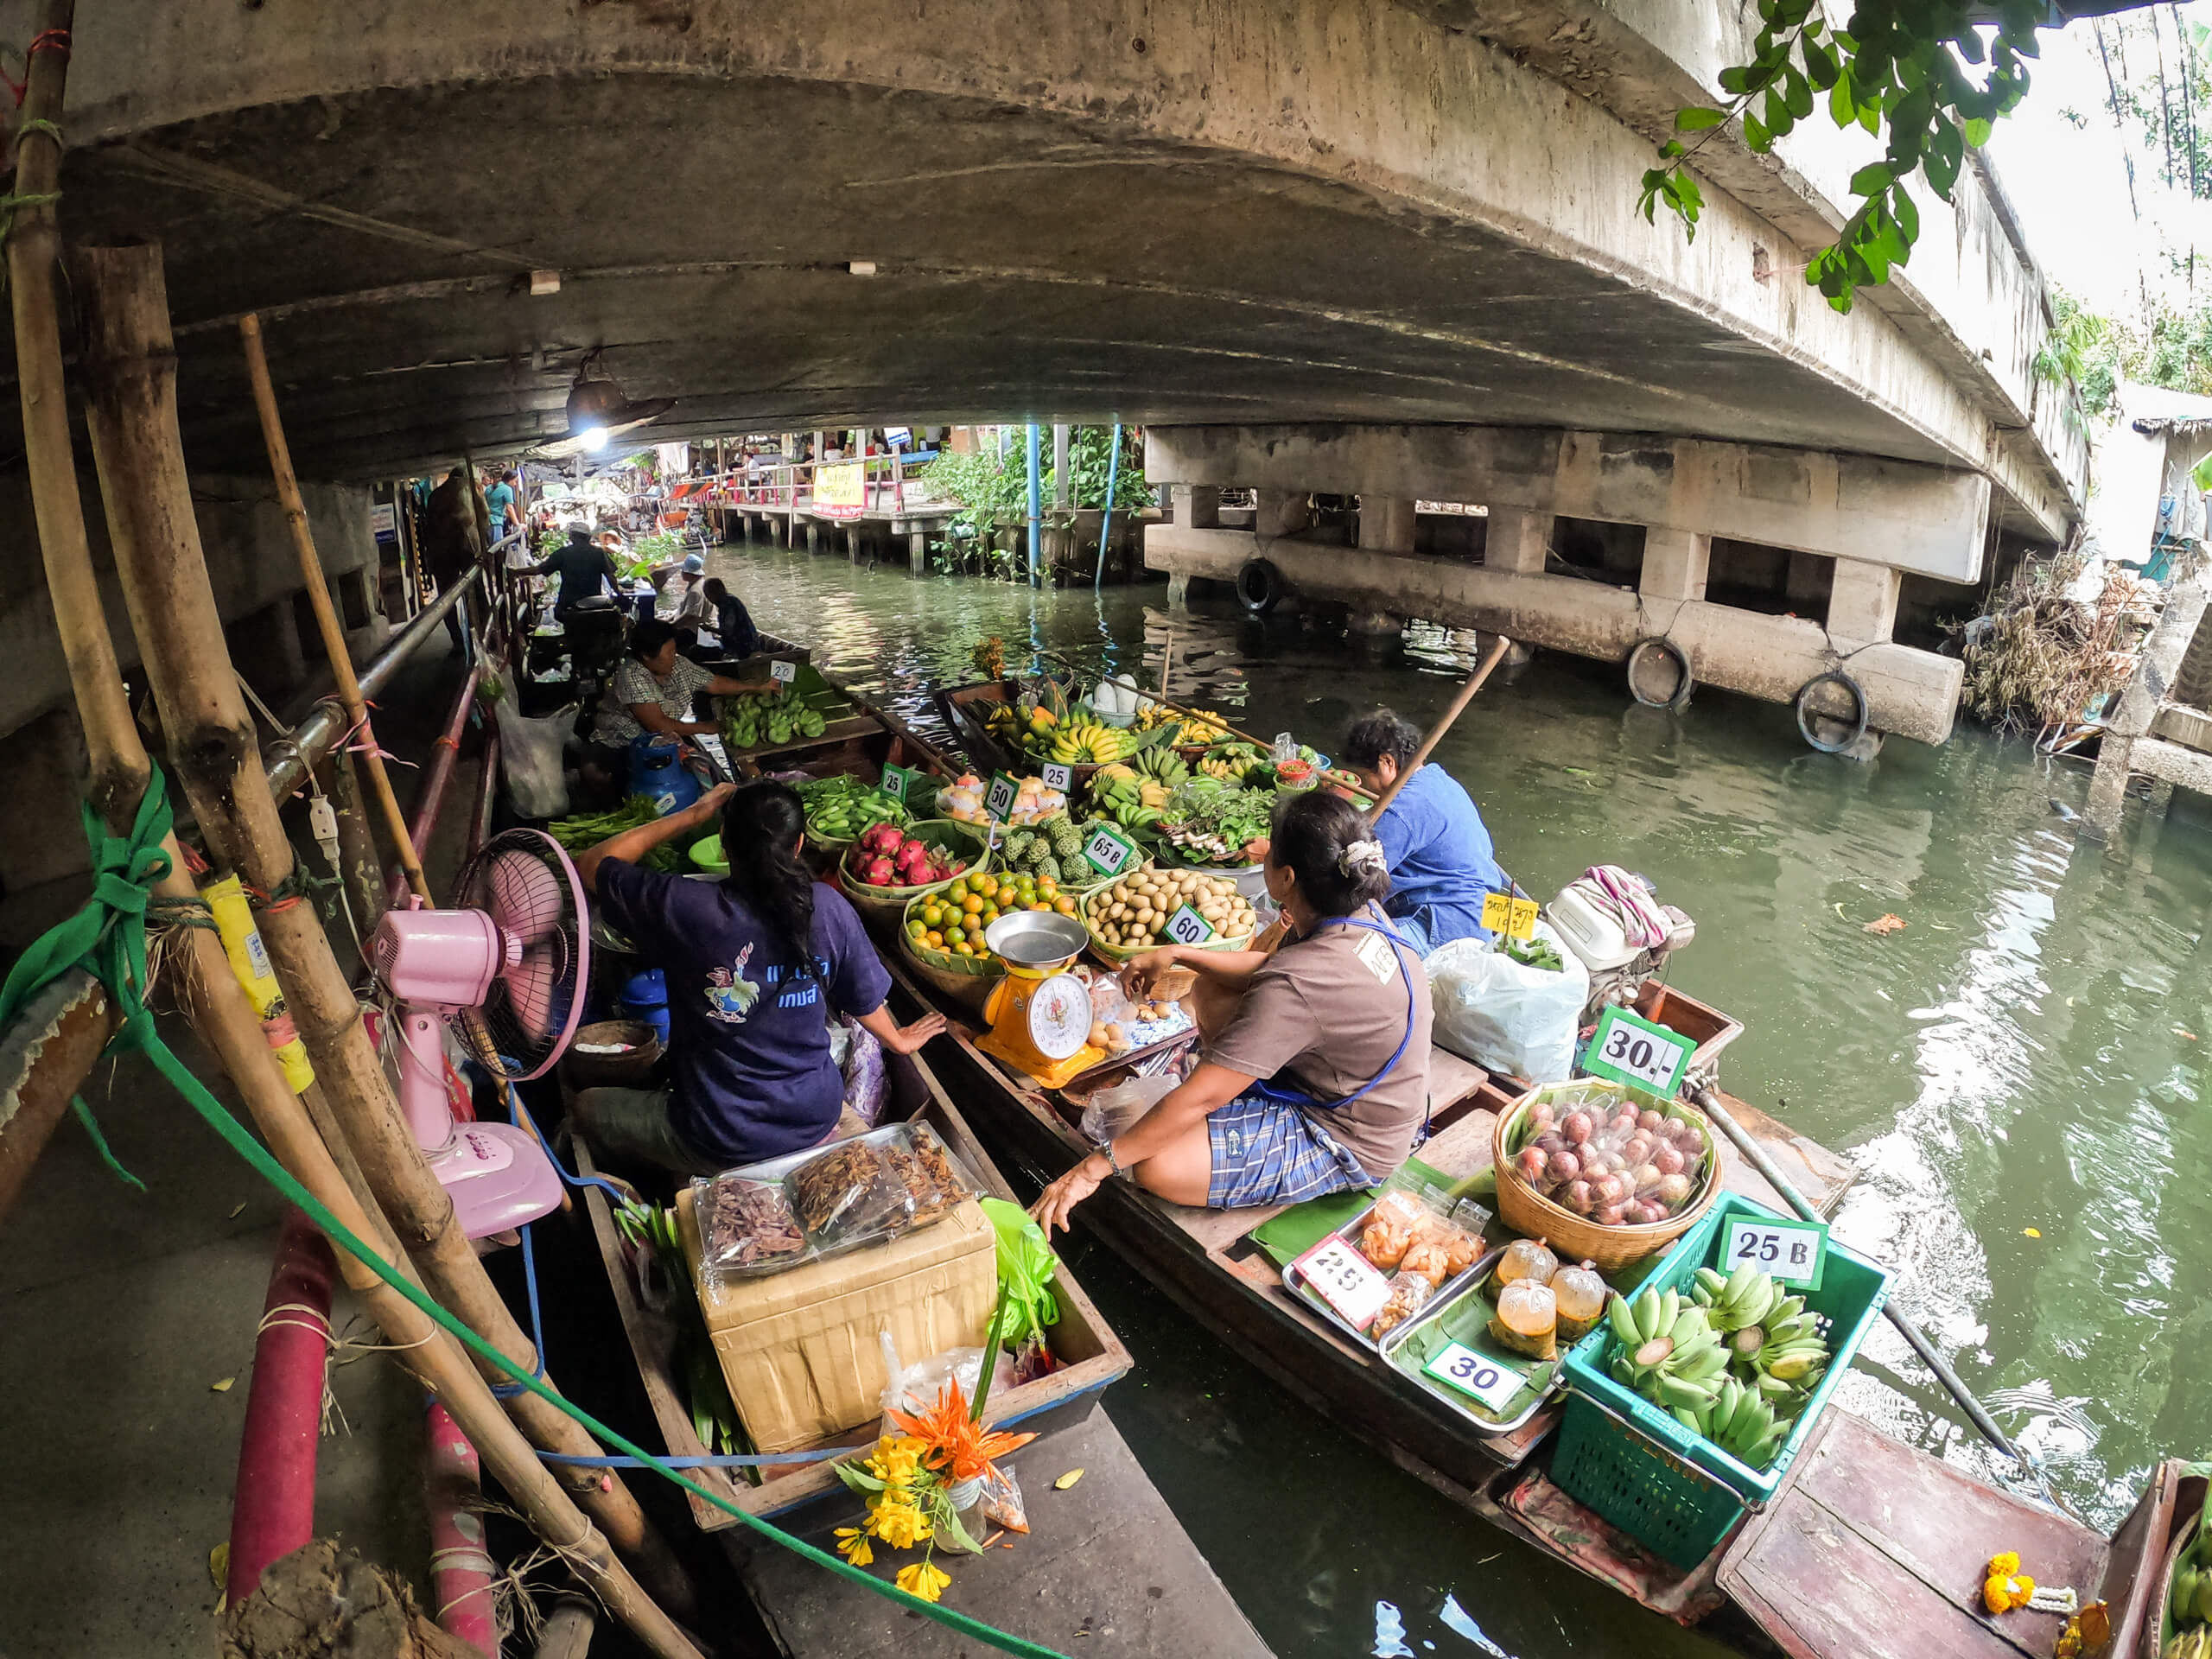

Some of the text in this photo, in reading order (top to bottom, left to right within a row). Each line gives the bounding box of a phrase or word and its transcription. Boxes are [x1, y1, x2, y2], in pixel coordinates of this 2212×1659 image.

[774, 665, 790, 677] 20
[887, 774, 899, 791] 25
[1048, 768, 1065, 785] 25
[991, 784, 1008, 808] 50
[1093, 837, 1114, 857] 65
[1176, 917, 1200, 944] 60
[1736, 1231, 1780, 1262] 25
[1450, 1357, 1499, 1389] 30
